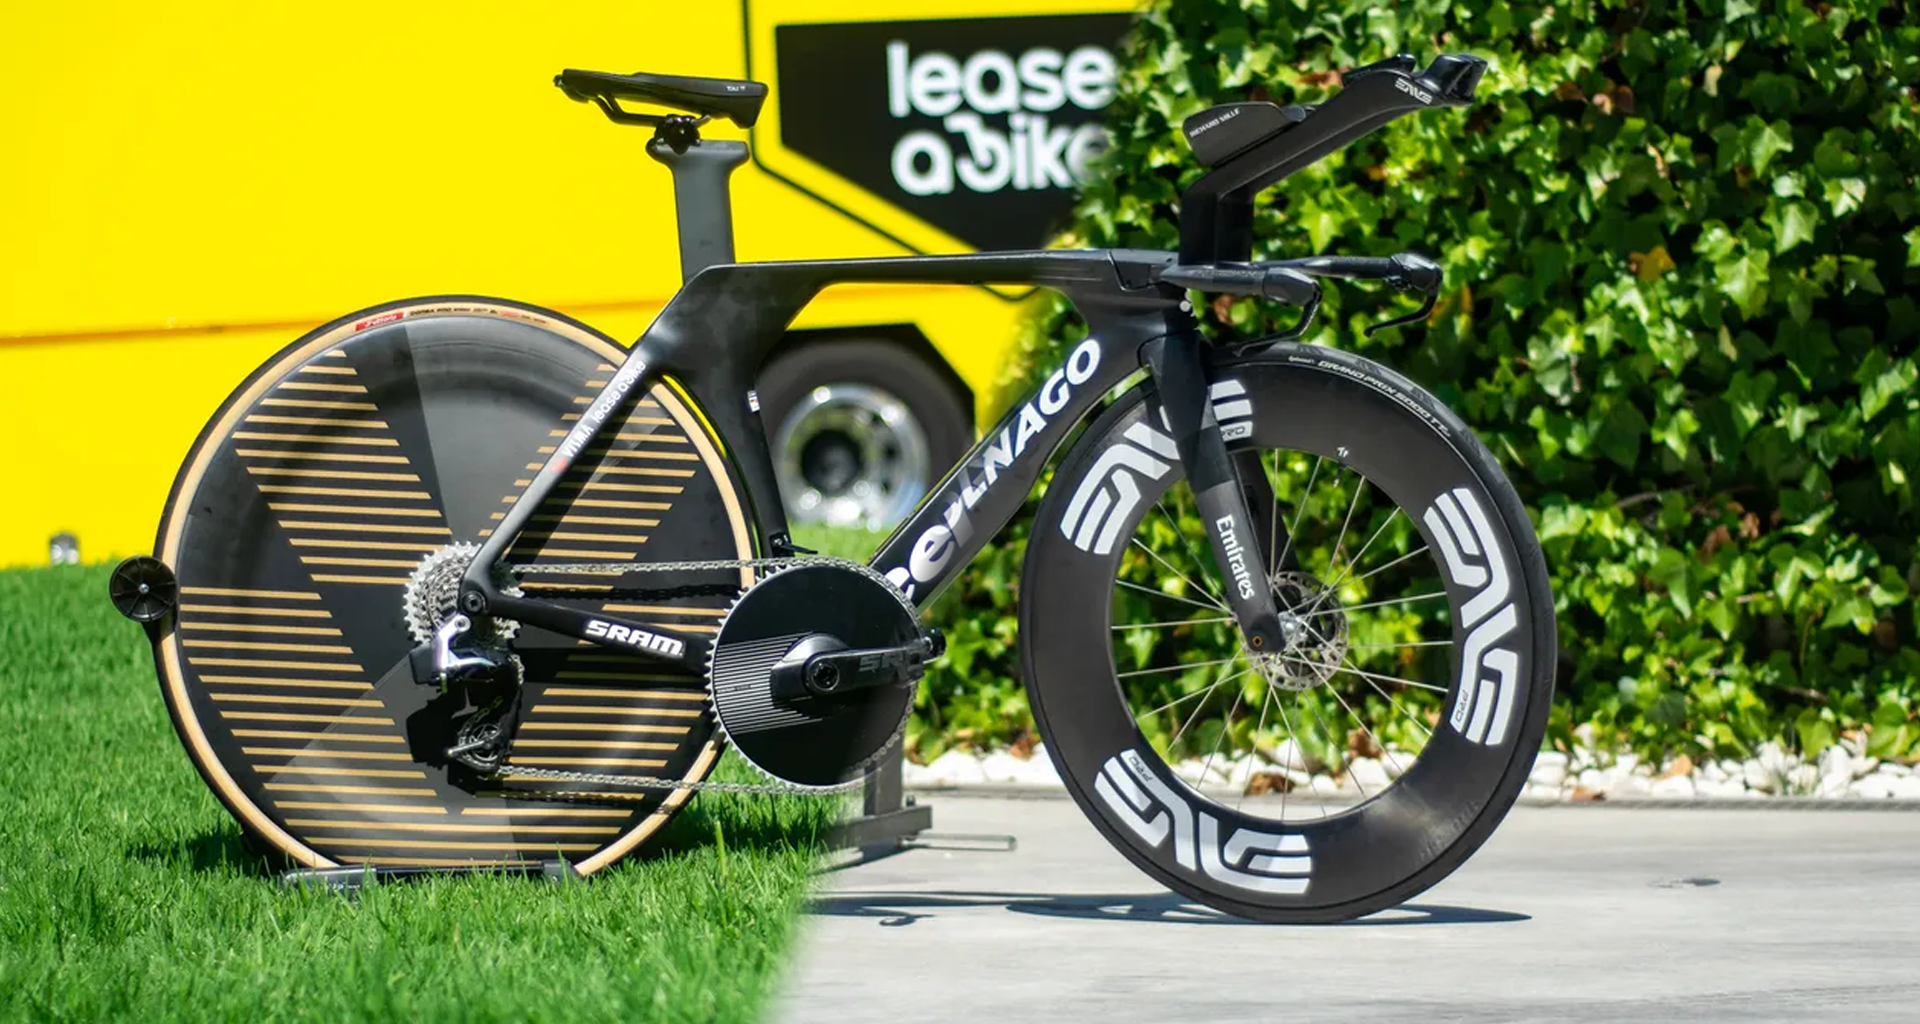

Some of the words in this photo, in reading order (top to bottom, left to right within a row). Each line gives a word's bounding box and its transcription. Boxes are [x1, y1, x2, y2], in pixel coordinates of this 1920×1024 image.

[886, 40, 1118, 117] lease
[1318, 360, 1364, 379] GRAND
[1364, 375, 1397, 394] PRIX
[1394, 391, 1431, 419] 5000
[1216, 513, 1256, 600] Emirates
[585, 619, 683, 656] SRAM
[1422, 487, 1518, 746] ENVE
[1094, 748, 1312, 894] ENVE
